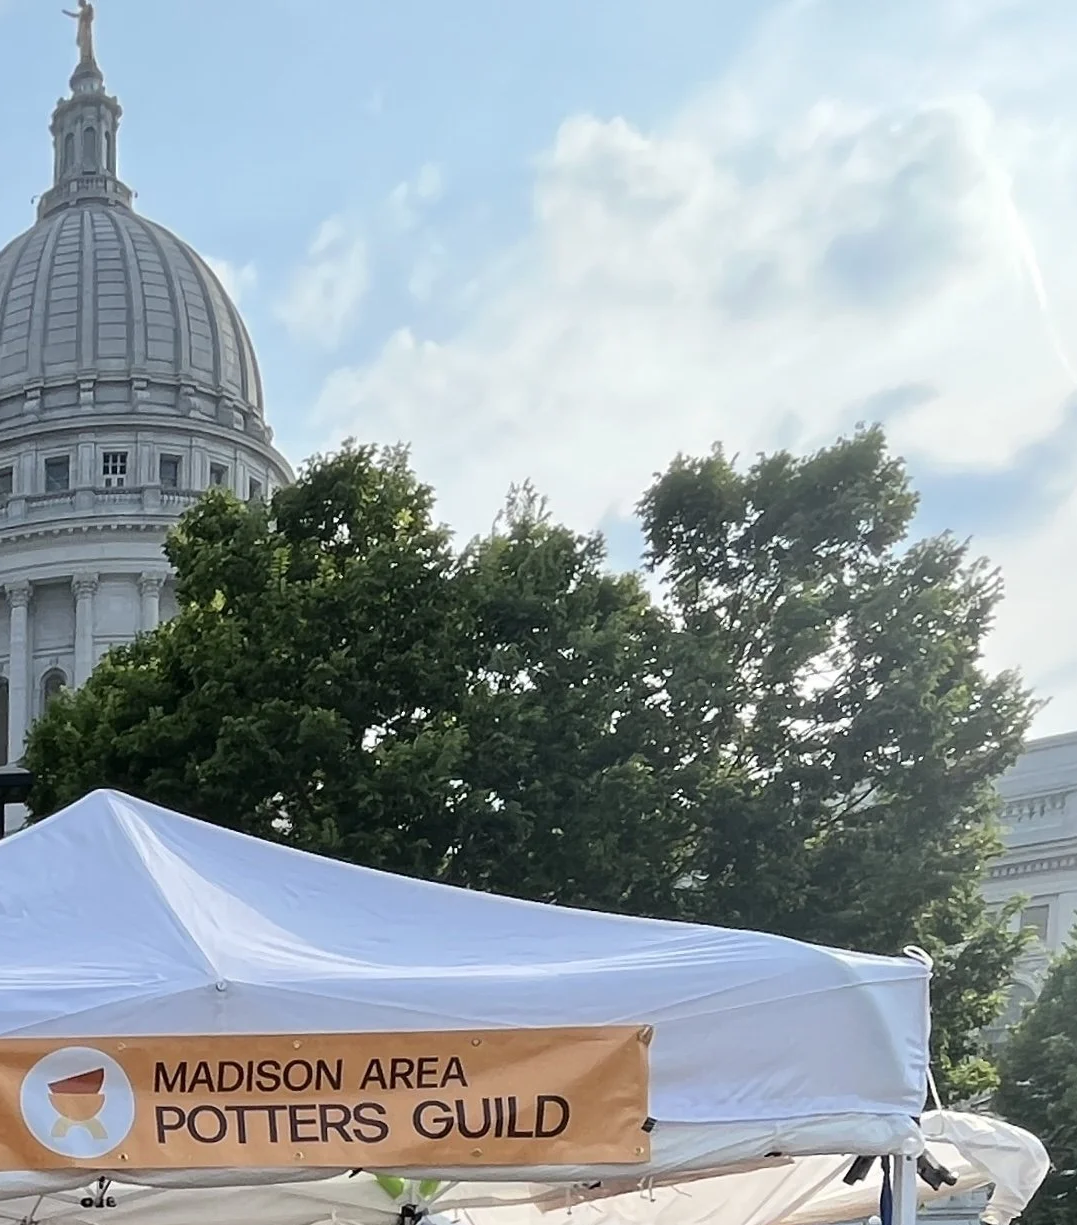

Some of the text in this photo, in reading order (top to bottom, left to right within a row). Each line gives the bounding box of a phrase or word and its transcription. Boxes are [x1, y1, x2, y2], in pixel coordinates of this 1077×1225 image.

[153, 1056, 469, 1094] MADISON AREA
[155, 1095, 570, 1144] POTTERS GUILD
